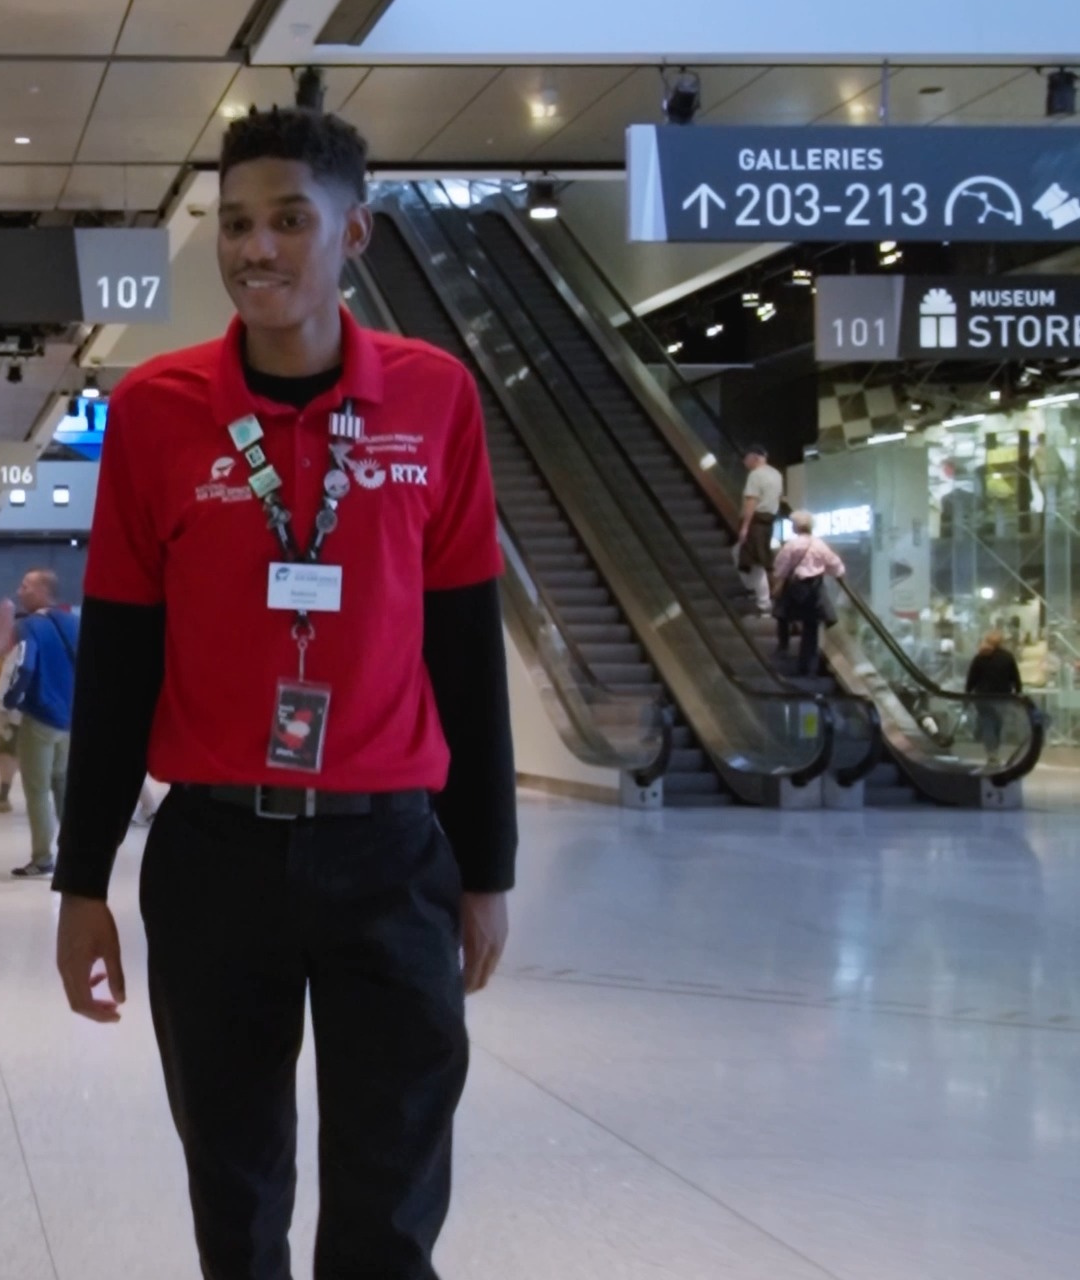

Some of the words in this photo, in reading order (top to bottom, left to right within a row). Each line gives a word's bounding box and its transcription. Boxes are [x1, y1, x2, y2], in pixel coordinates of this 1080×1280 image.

[738, 148, 883, 171] GALLERIES
[735, 182, 928, 226] 203-213
[97, 276, 161, 309] 107
[970, 289, 1056, 307] MUSEUM
[833, 318, 885, 347] 101
[0, 465, 33, 484] 106
[390, 463, 428, 486] RTX
